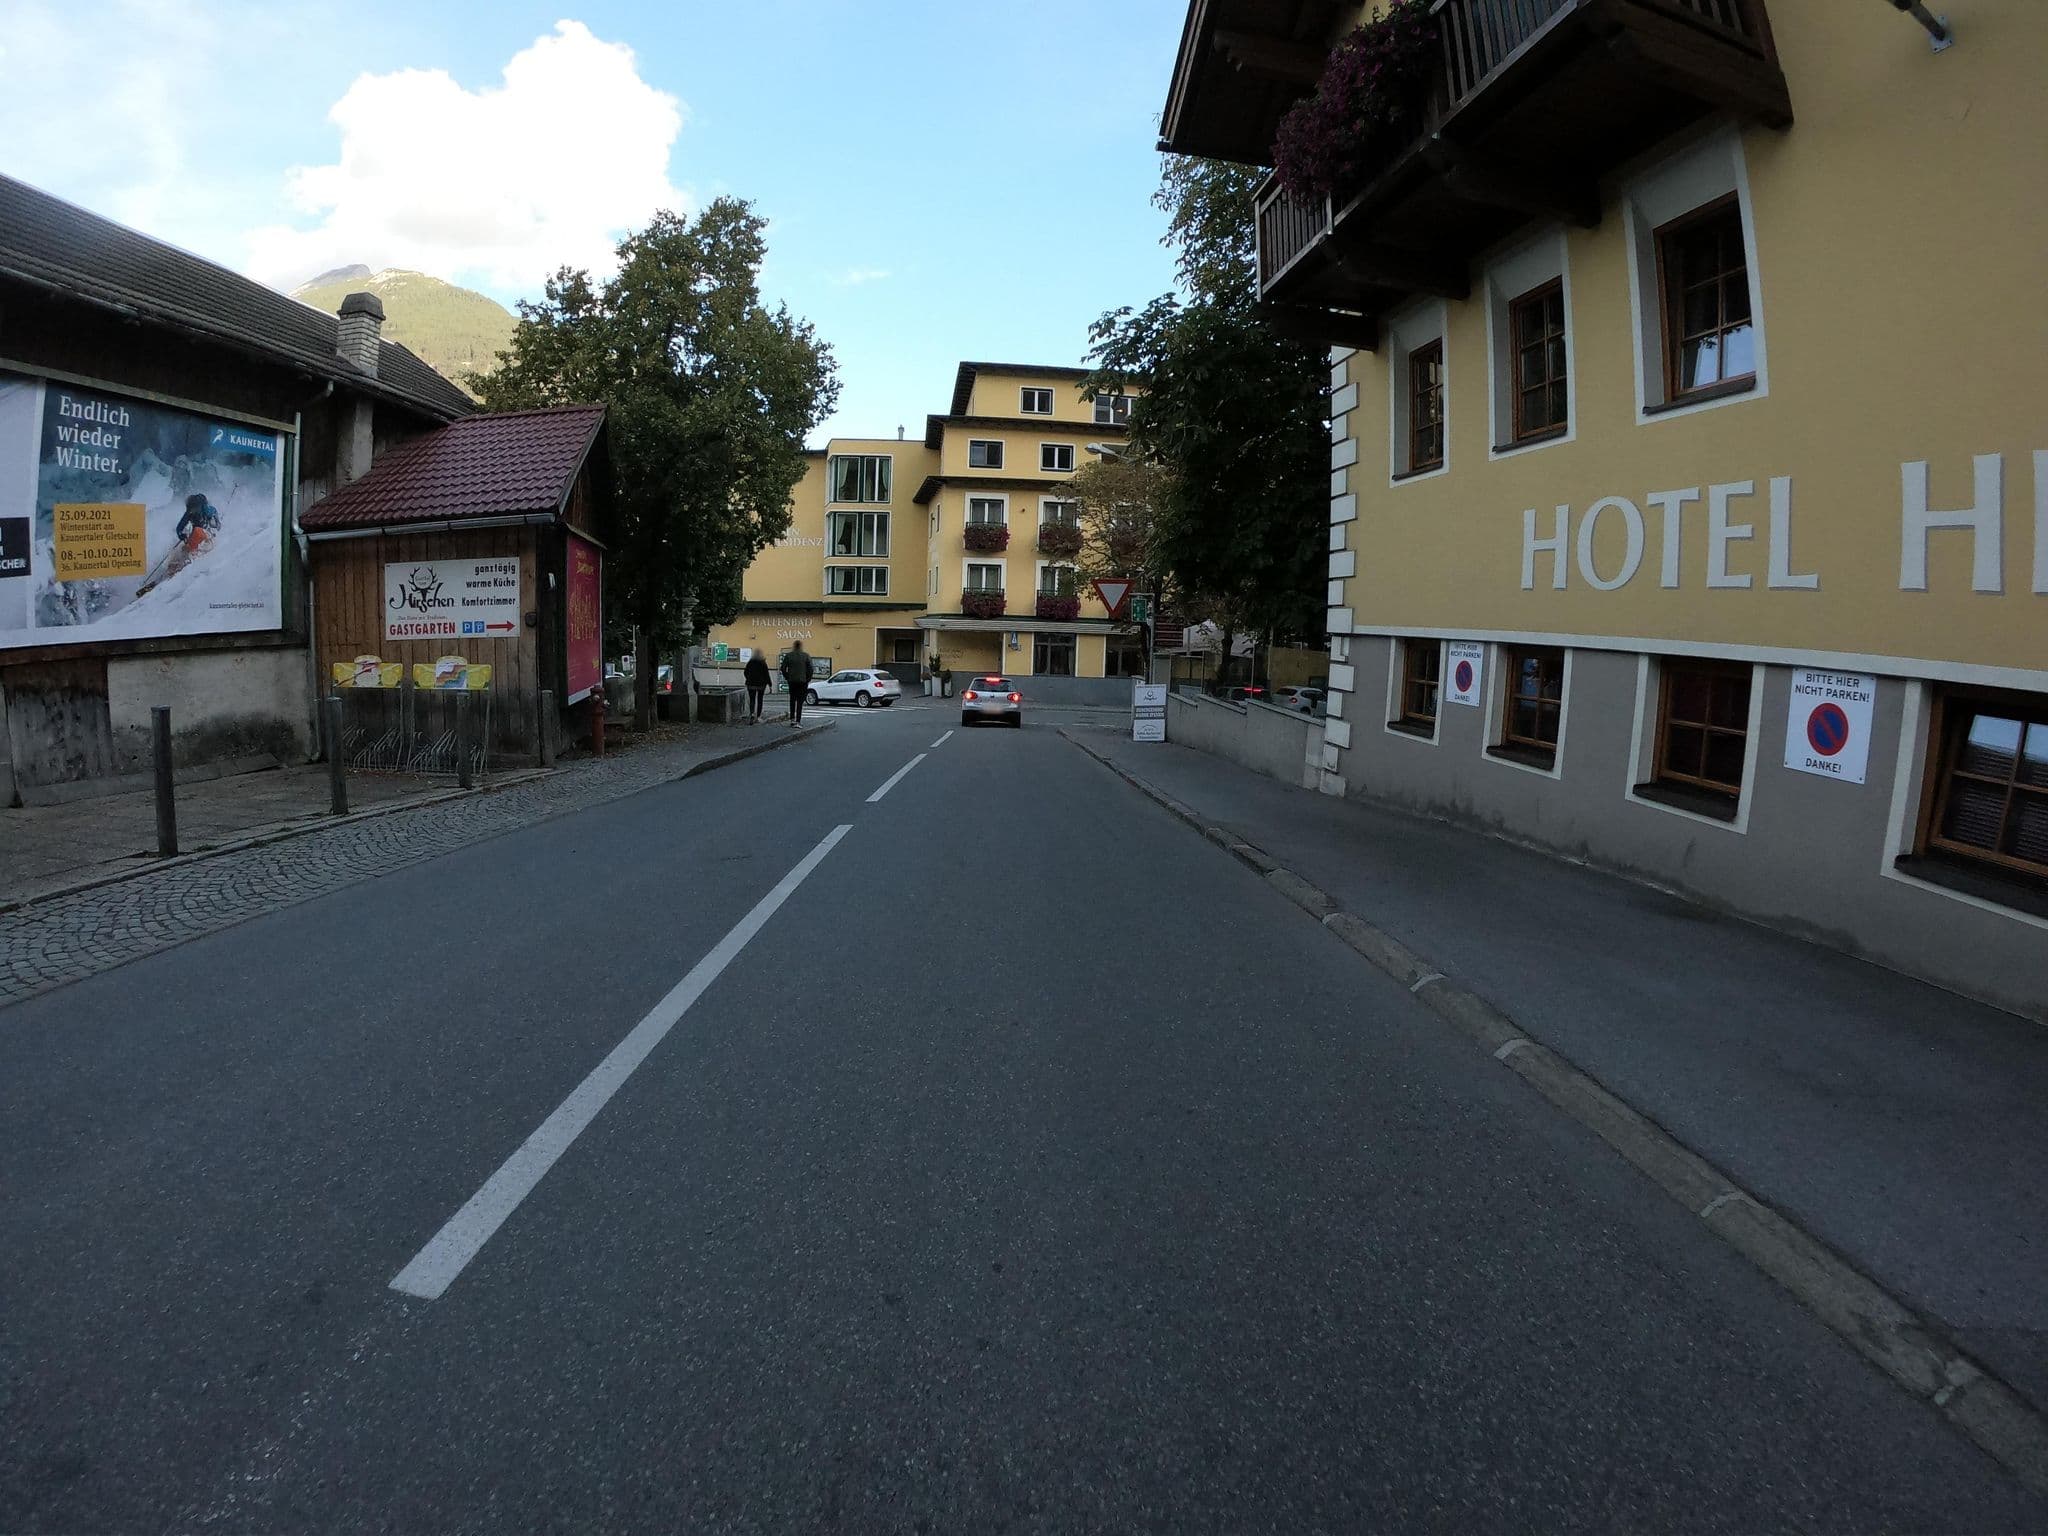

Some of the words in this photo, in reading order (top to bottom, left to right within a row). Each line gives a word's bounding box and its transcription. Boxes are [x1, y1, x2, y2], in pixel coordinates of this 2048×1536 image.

[59, 394, 130, 427] Endlich
[57, 423, 121, 449] wieder
[230, 434, 275, 452] KAUNERTAL
[56, 446, 122, 474] Winter.
[60, 510, 111, 521] 25.09.2021
[1520, 476, 1818, 590] HOTEL
[774, 538, 823, 547] ESIDENZ
[0, 558, 26, 570] CHER
[475, 562, 516, 575] ganztägig
[466, 579, 491, 588] warme
[493, 577, 516, 588] Küche
[389, 582, 455, 613] Hirschen
[461, 597, 516, 607] Komfortzimmer
[389, 622, 456, 636] GASTGARTEN
[752, 617, 812, 627] HALLENBAD
[776, 629, 812, 640] SAUNA
[1806, 673, 1833, 685] BITTE
[1836, 676, 1860, 688] HIER
[1795, 685, 1823, 697] NICHT
[1826, 688, 1870, 703] PARKEN!
[1805, 758, 1842, 773] DANKE!
